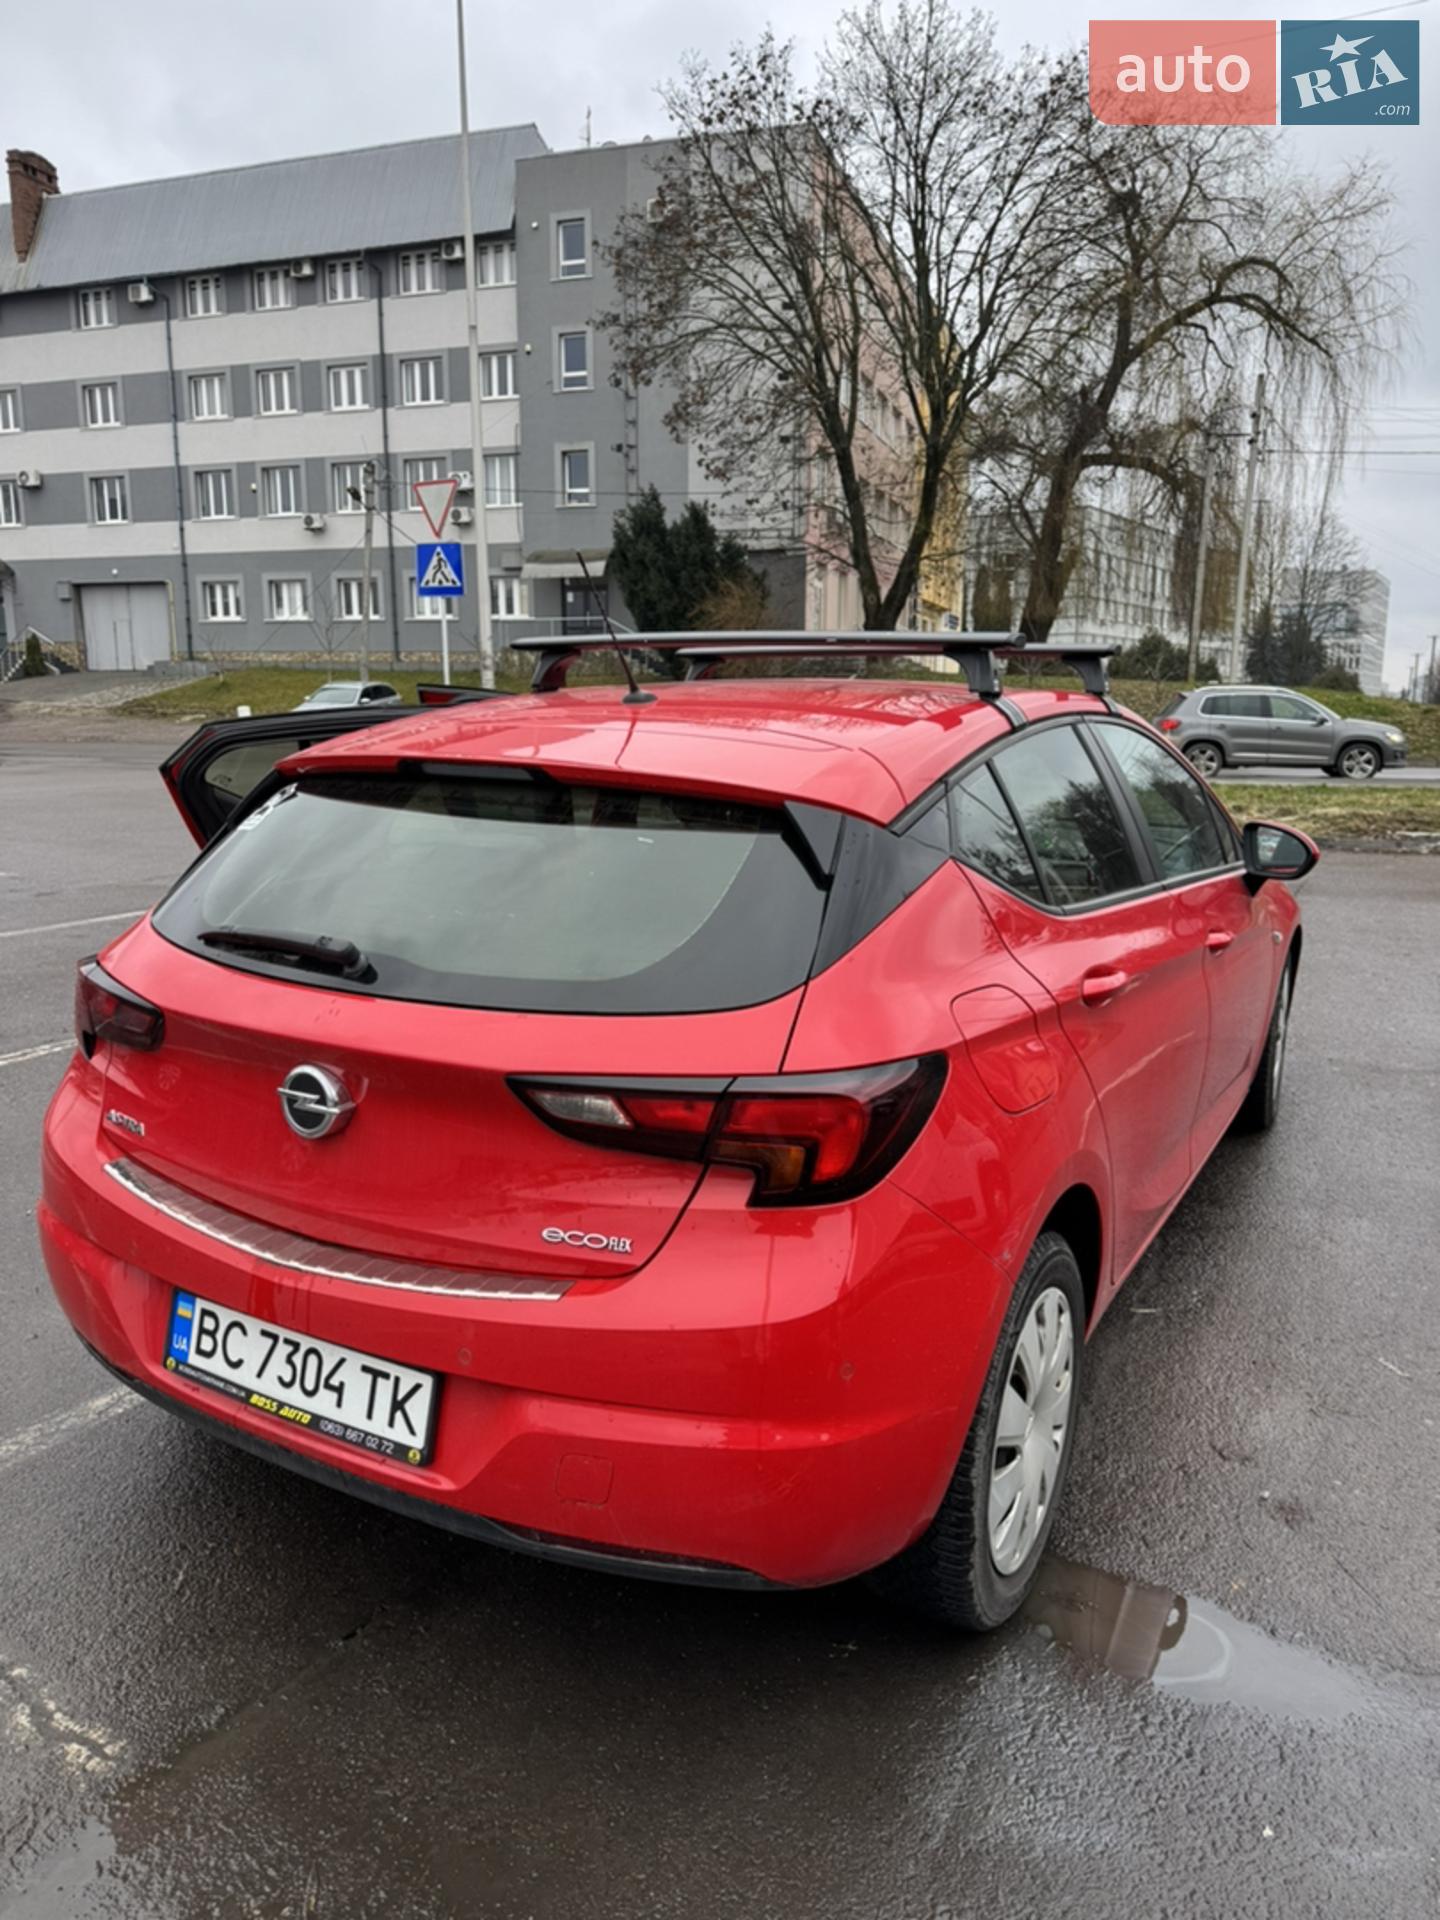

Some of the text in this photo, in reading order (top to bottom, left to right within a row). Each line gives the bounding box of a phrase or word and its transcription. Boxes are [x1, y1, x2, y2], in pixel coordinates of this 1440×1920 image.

[173, 1333, 188, 1352] UA
[195, 1308, 248, 1369] BC
[256, 1329, 347, 1408] 7304
[361, 1364, 423, 1437] TK
[279, 1405, 312, 1424] AUTO
[381, 1440, 395, 1455] 72
